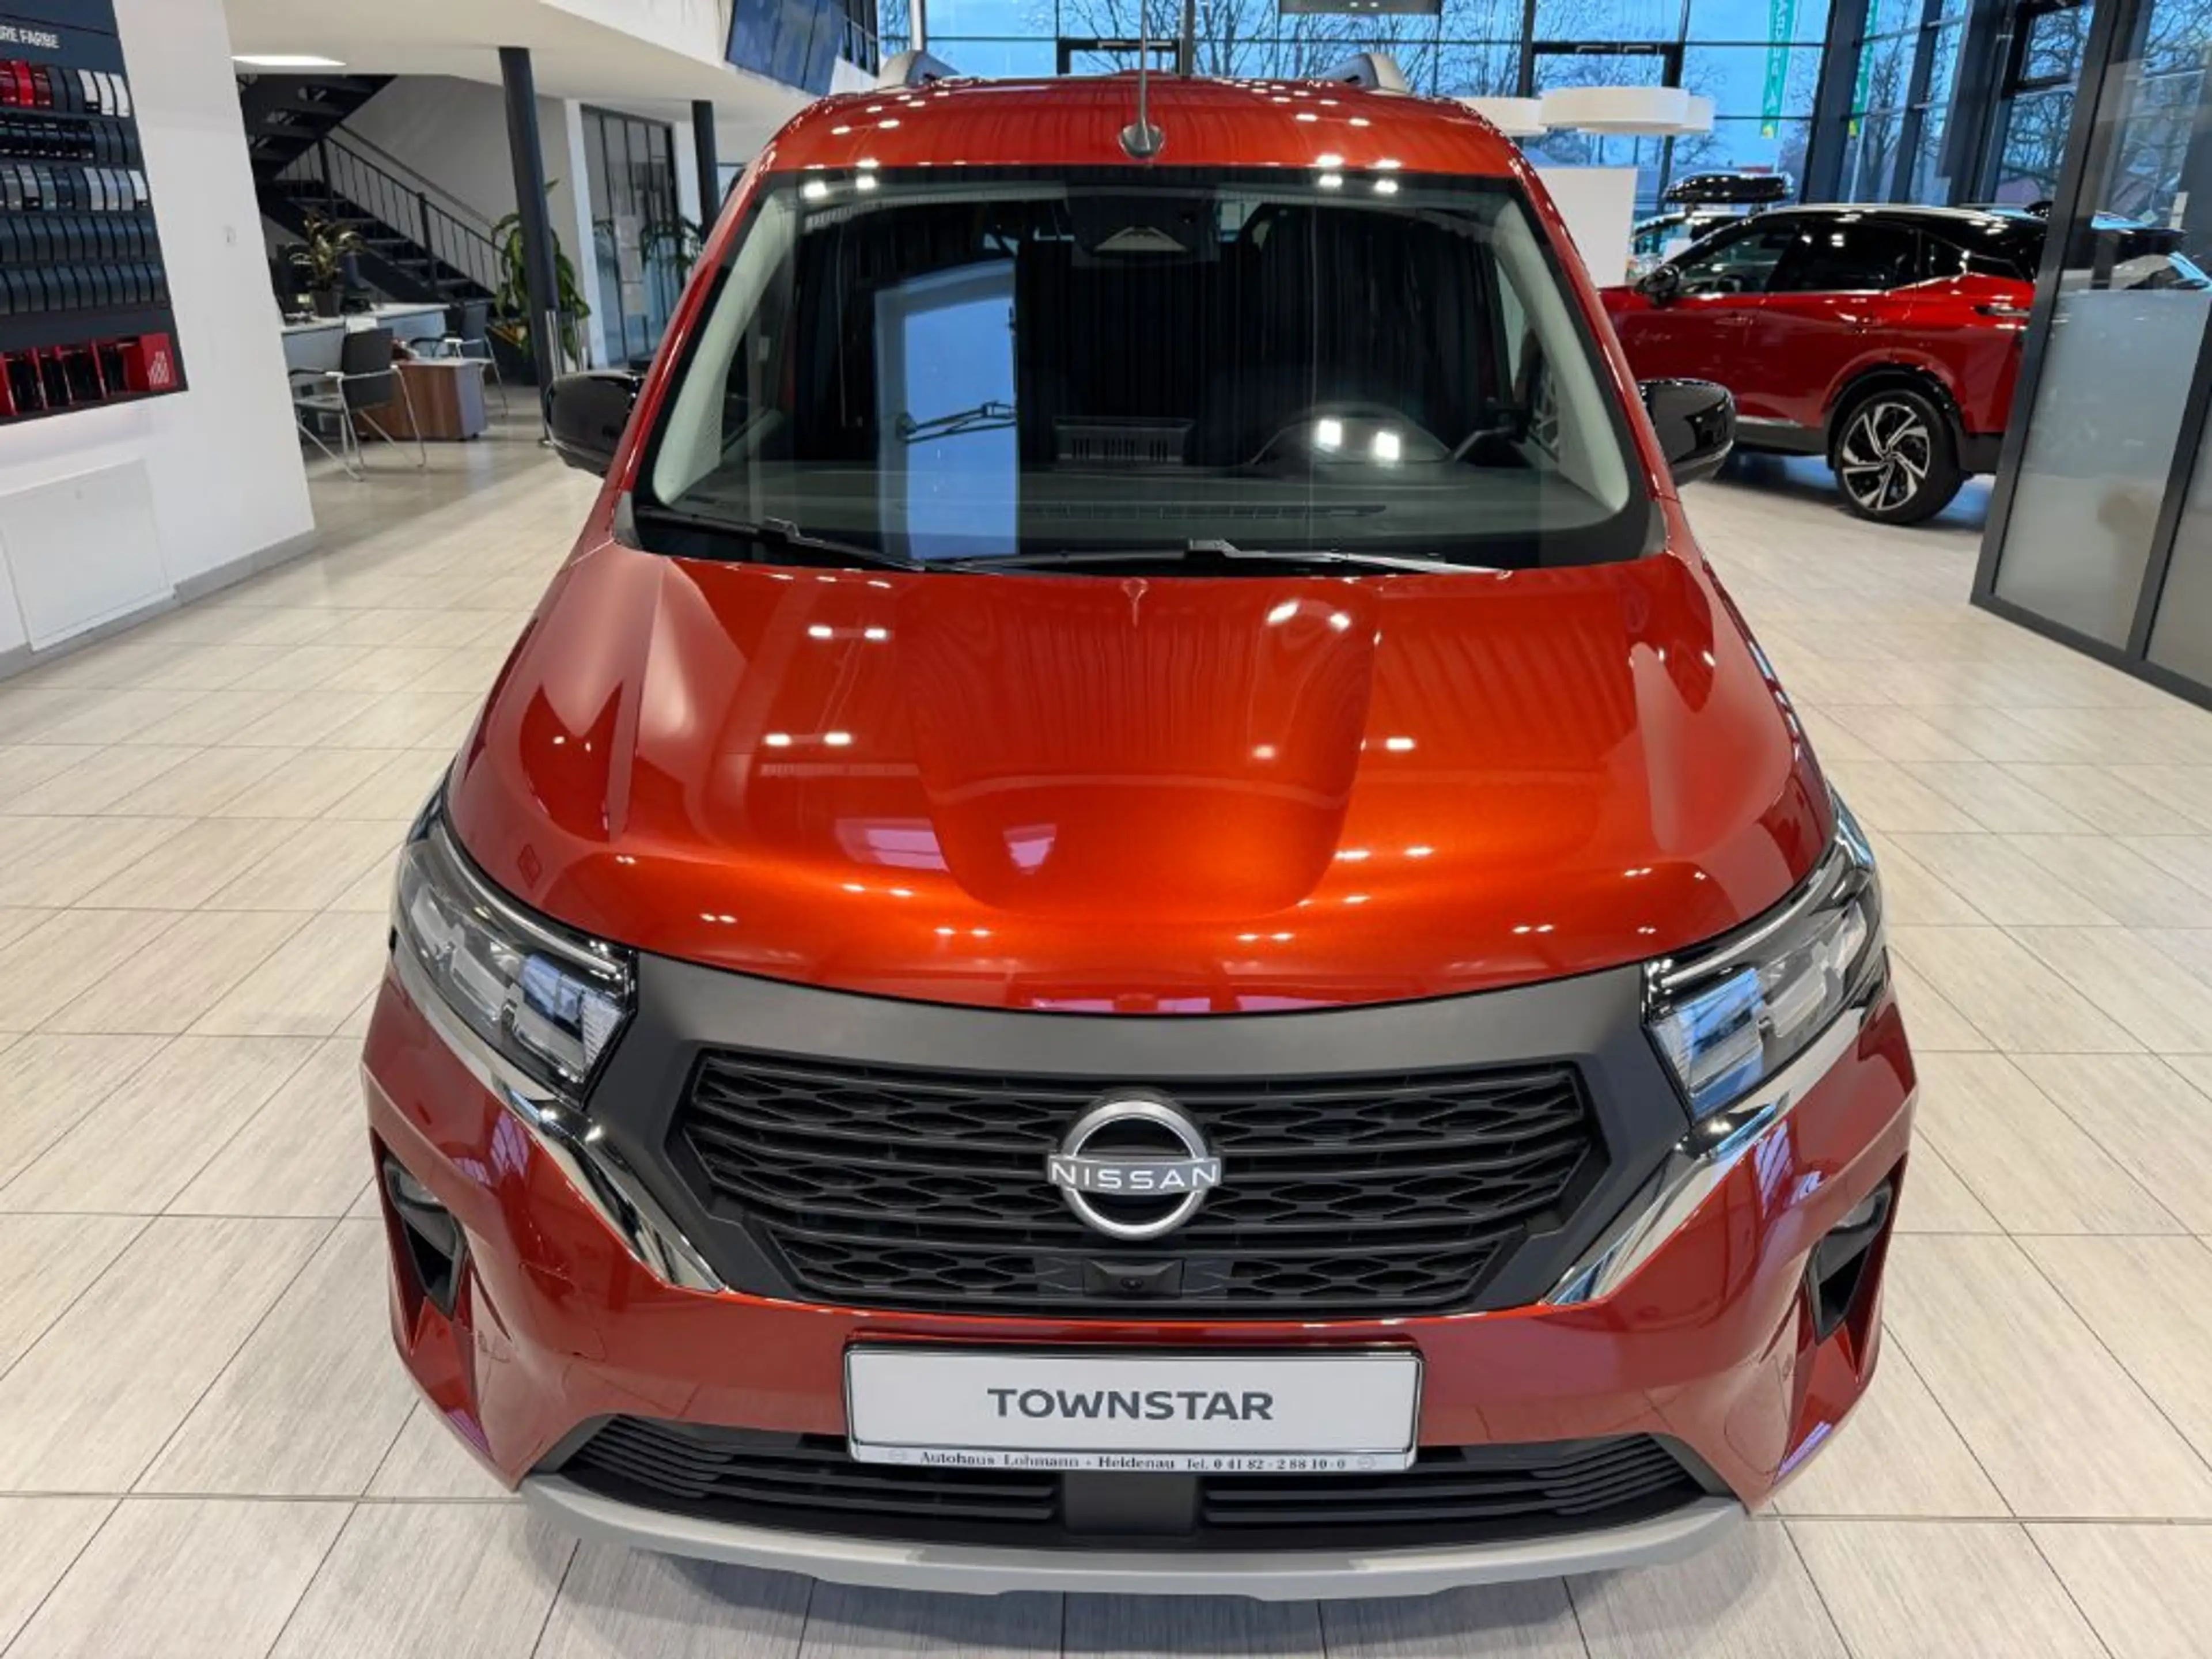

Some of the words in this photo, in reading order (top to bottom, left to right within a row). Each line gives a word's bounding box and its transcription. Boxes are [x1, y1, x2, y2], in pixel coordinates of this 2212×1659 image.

[20, 29, 60, 48] FARBE
[1051, 1162, 1217, 1190] NISSAN
[987, 1388, 1274, 1421] TOWNSTAR
[921, 1451, 995, 1465] Autohaus
[1003, 1453, 1080, 1468] Lohmann
[1099, 1456, 1175, 1469] Heidenau
[1187, 1459, 1209, 1469] Tel.
